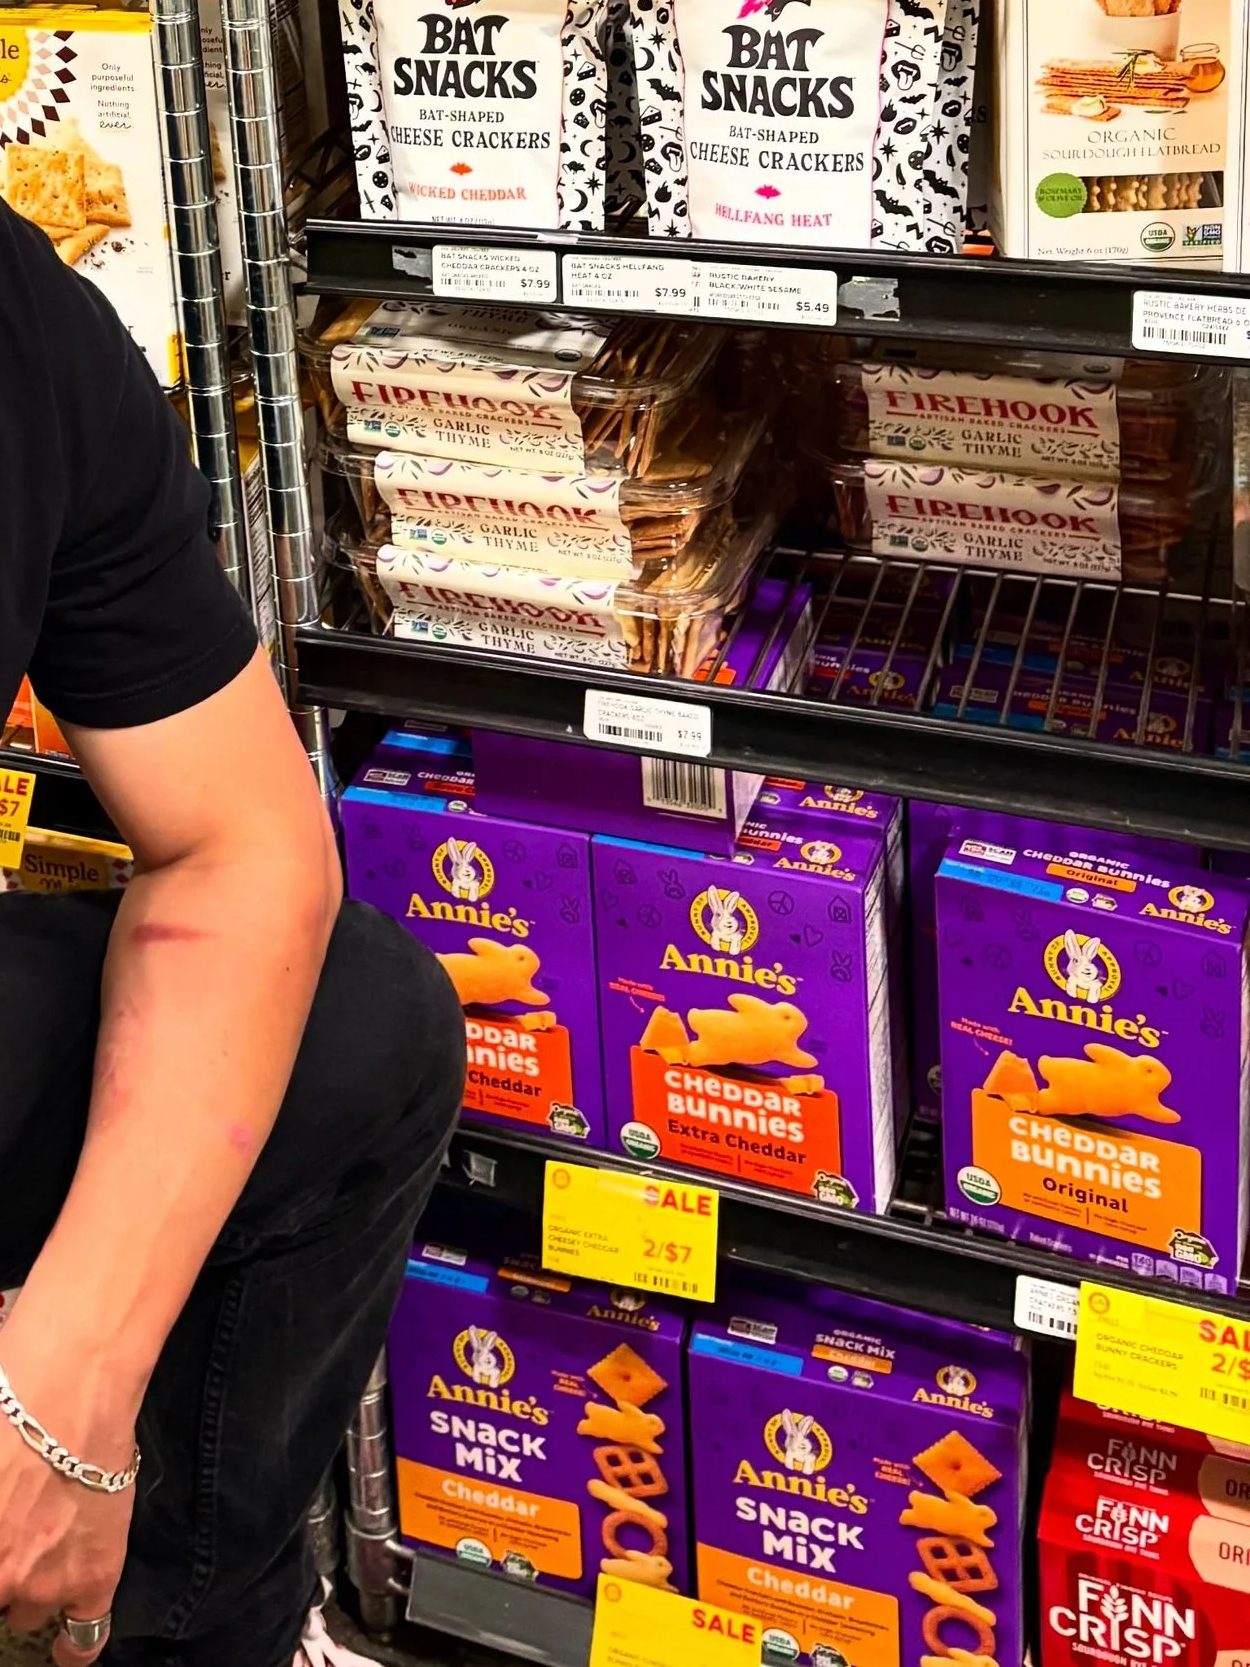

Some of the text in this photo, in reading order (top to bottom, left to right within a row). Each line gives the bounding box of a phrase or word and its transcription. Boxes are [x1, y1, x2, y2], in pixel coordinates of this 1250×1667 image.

[416, 12, 510, 56] BAT
[91, 73, 135, 84] purposeful
[101, 62, 121, 74] Only
[392, 57, 539, 101] SNACKS
[97, 100, 130, 111] Nothing
[418, 108, 505, 125] BAT-SHAPED
[389, 123, 552, 151] CHEESE CRACKERS
[1086, 127, 1177, 145] ORGANIC
[407, 181, 527, 203] WICKED CHEDDAR
[714, 202, 833, 229] HELLFANG HEAT
[440, 251, 521, 263] BAT SNACKS WICKED
[520, 276, 552, 290] $7.99
[795, 300, 830, 314] $5.49
[885, 389, 1101, 431] FIREHOOK
[960, 428, 1024, 446] GARLIC
[962, 441, 1023, 460] THYME
[660, 943, 798, 996] Annie's
[667, 1119, 807, 1165] Extra Cheddar
[1041, 1176, 1129, 1214] Original
[732, 1459, 871, 1516] Annie's
[746, 1567, 855, 1611] Cheddar
[691, 1608, 756, 1644] SALE
[1050, 1605, 1183, 1662] CRISP
